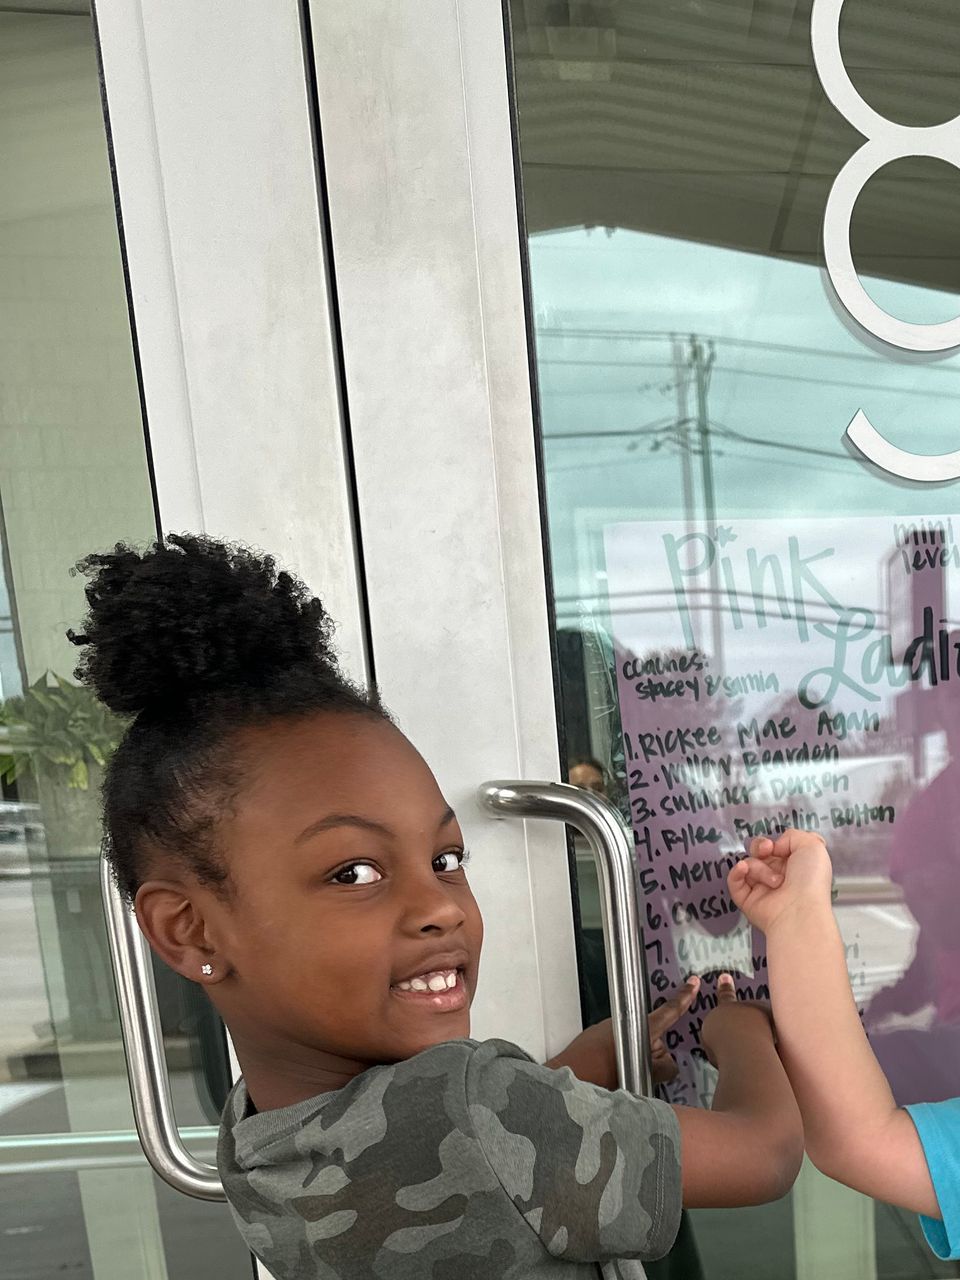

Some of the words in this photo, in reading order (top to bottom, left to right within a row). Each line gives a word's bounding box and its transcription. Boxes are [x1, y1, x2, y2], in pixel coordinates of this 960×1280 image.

[662, 526, 848, 650] Pink
[736, 716, 797, 748] Mae
[630, 769, 660, 791] 2.
[632, 797, 656, 824] 3.
[639, 868, 666, 895] 5.
[646, 902, 668, 931] 6.
[645, 939, 670, 966] 7.
[651, 968, 676, 992] 8.
